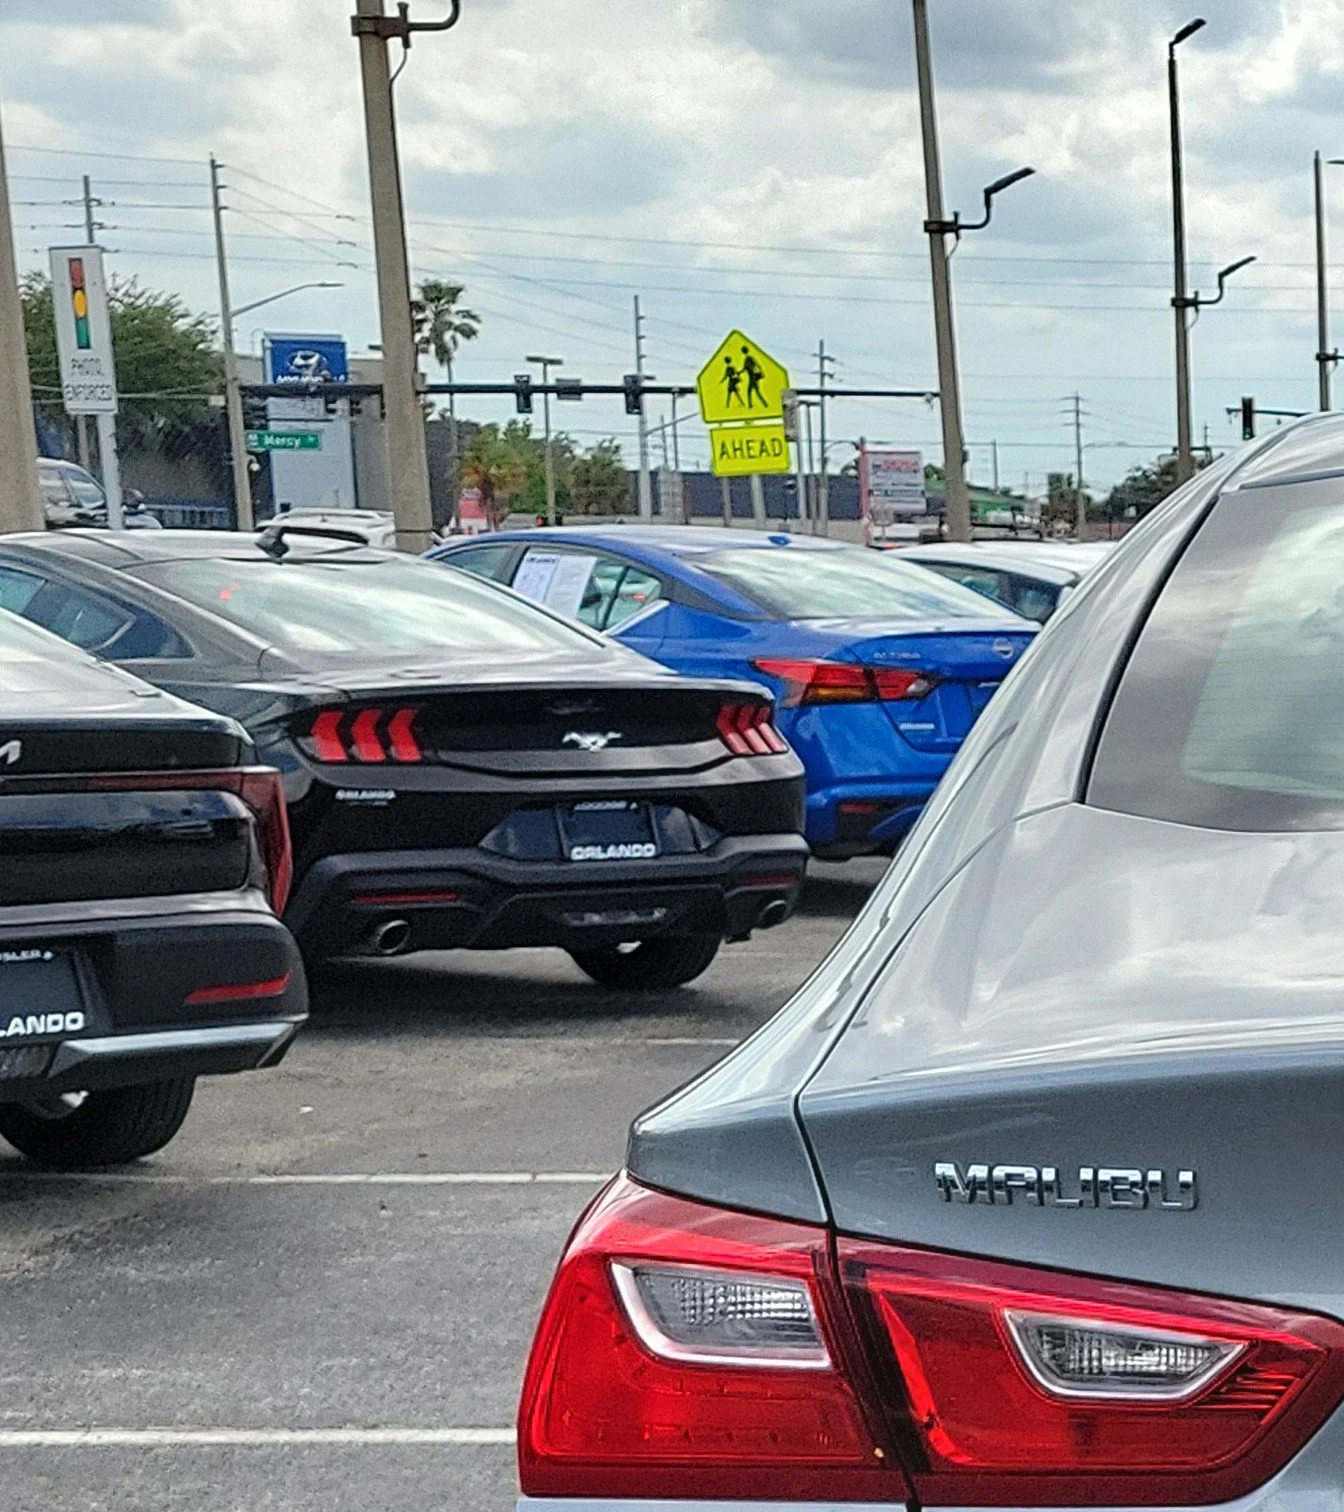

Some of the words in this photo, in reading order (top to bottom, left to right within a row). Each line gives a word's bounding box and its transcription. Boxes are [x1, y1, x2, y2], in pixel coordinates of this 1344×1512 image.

[719, 438, 783, 460] AHEAD
[571, 843, 656, 860] ORLANDO
[934, 1162, 1200, 1211] MALIBU
